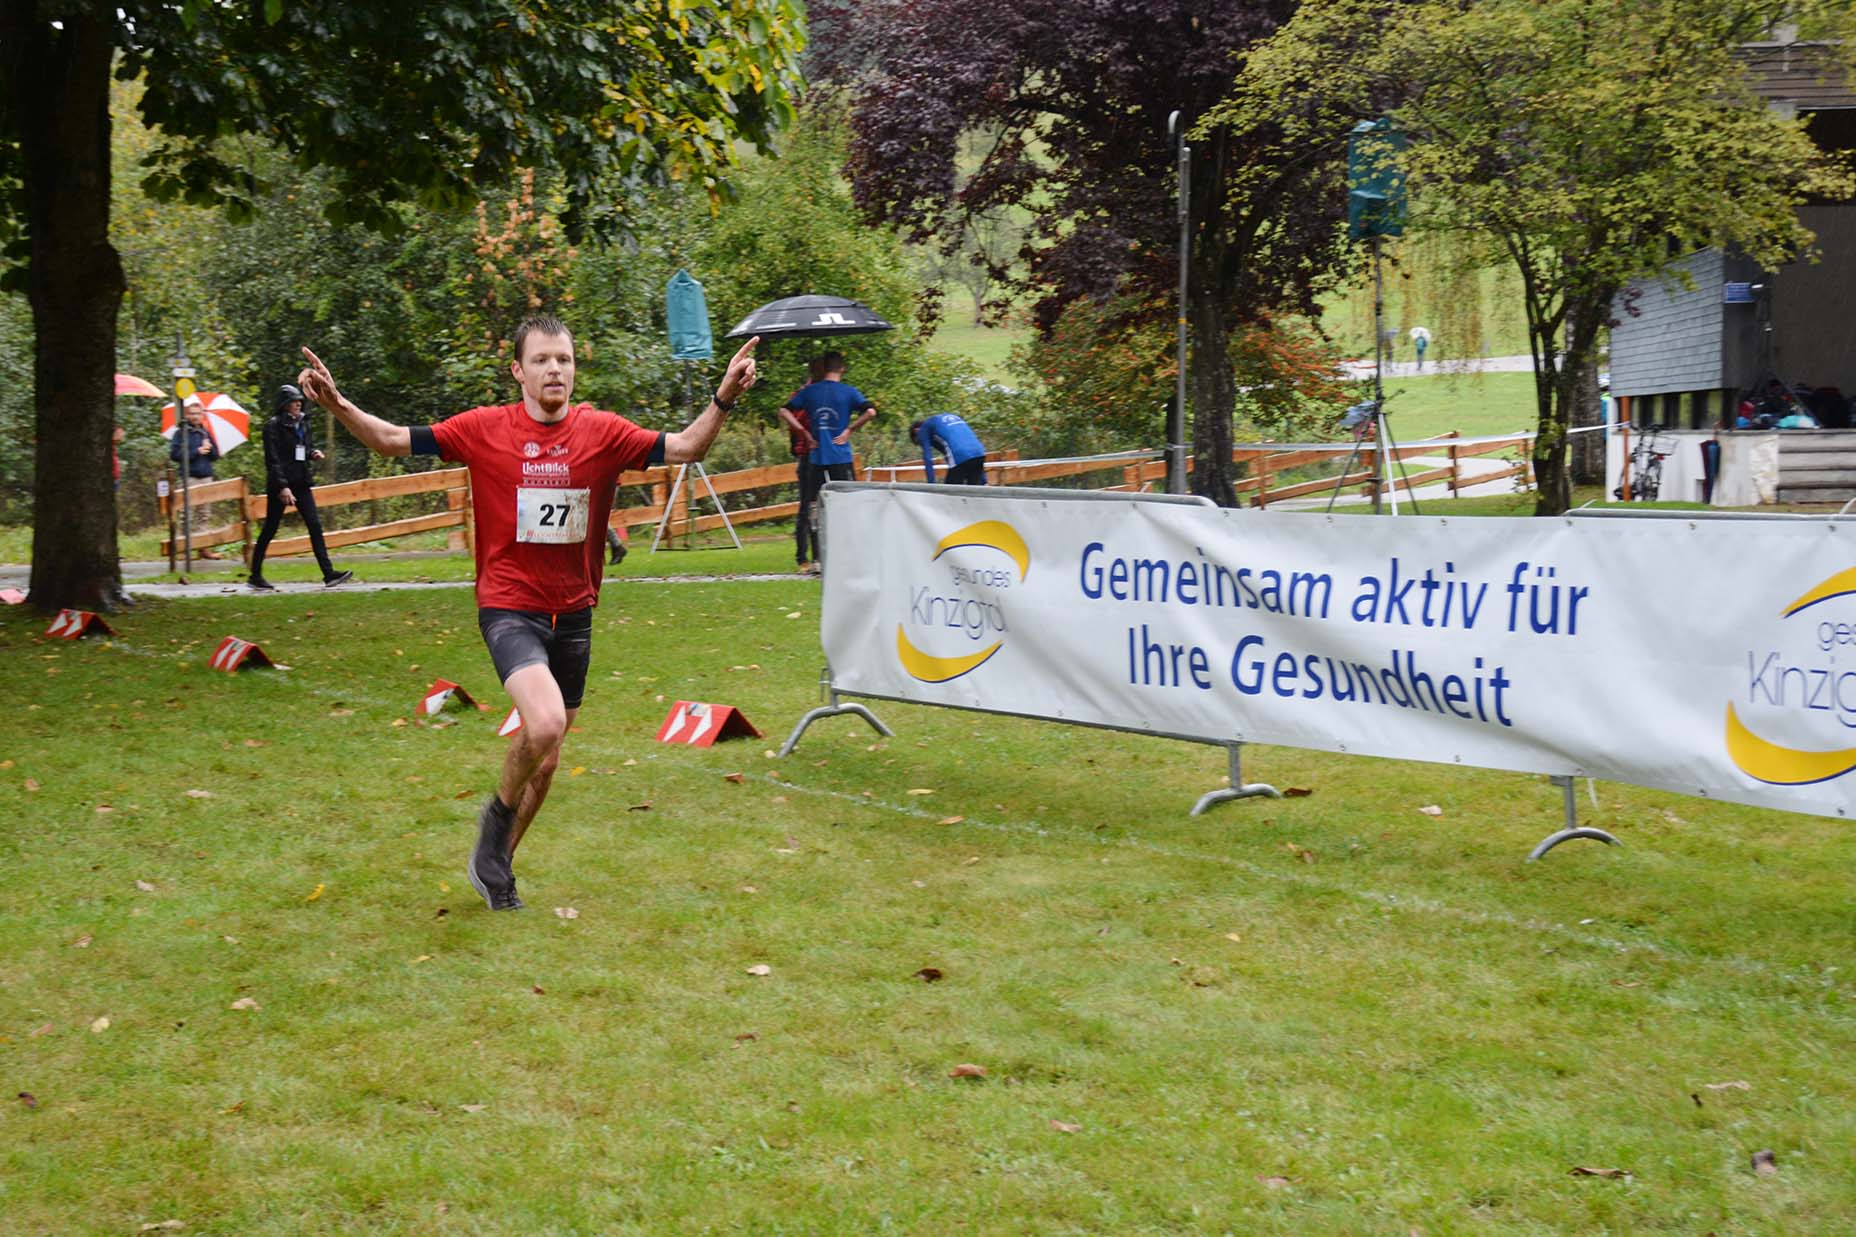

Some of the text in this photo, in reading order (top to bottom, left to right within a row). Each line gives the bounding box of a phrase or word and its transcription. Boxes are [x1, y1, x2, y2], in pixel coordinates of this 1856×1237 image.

[539, 503, 571, 527] 27
[1080, 541, 1590, 636] Gemeinsam aktiv für
[1128, 624, 1512, 727] Ihre Gesundheit
